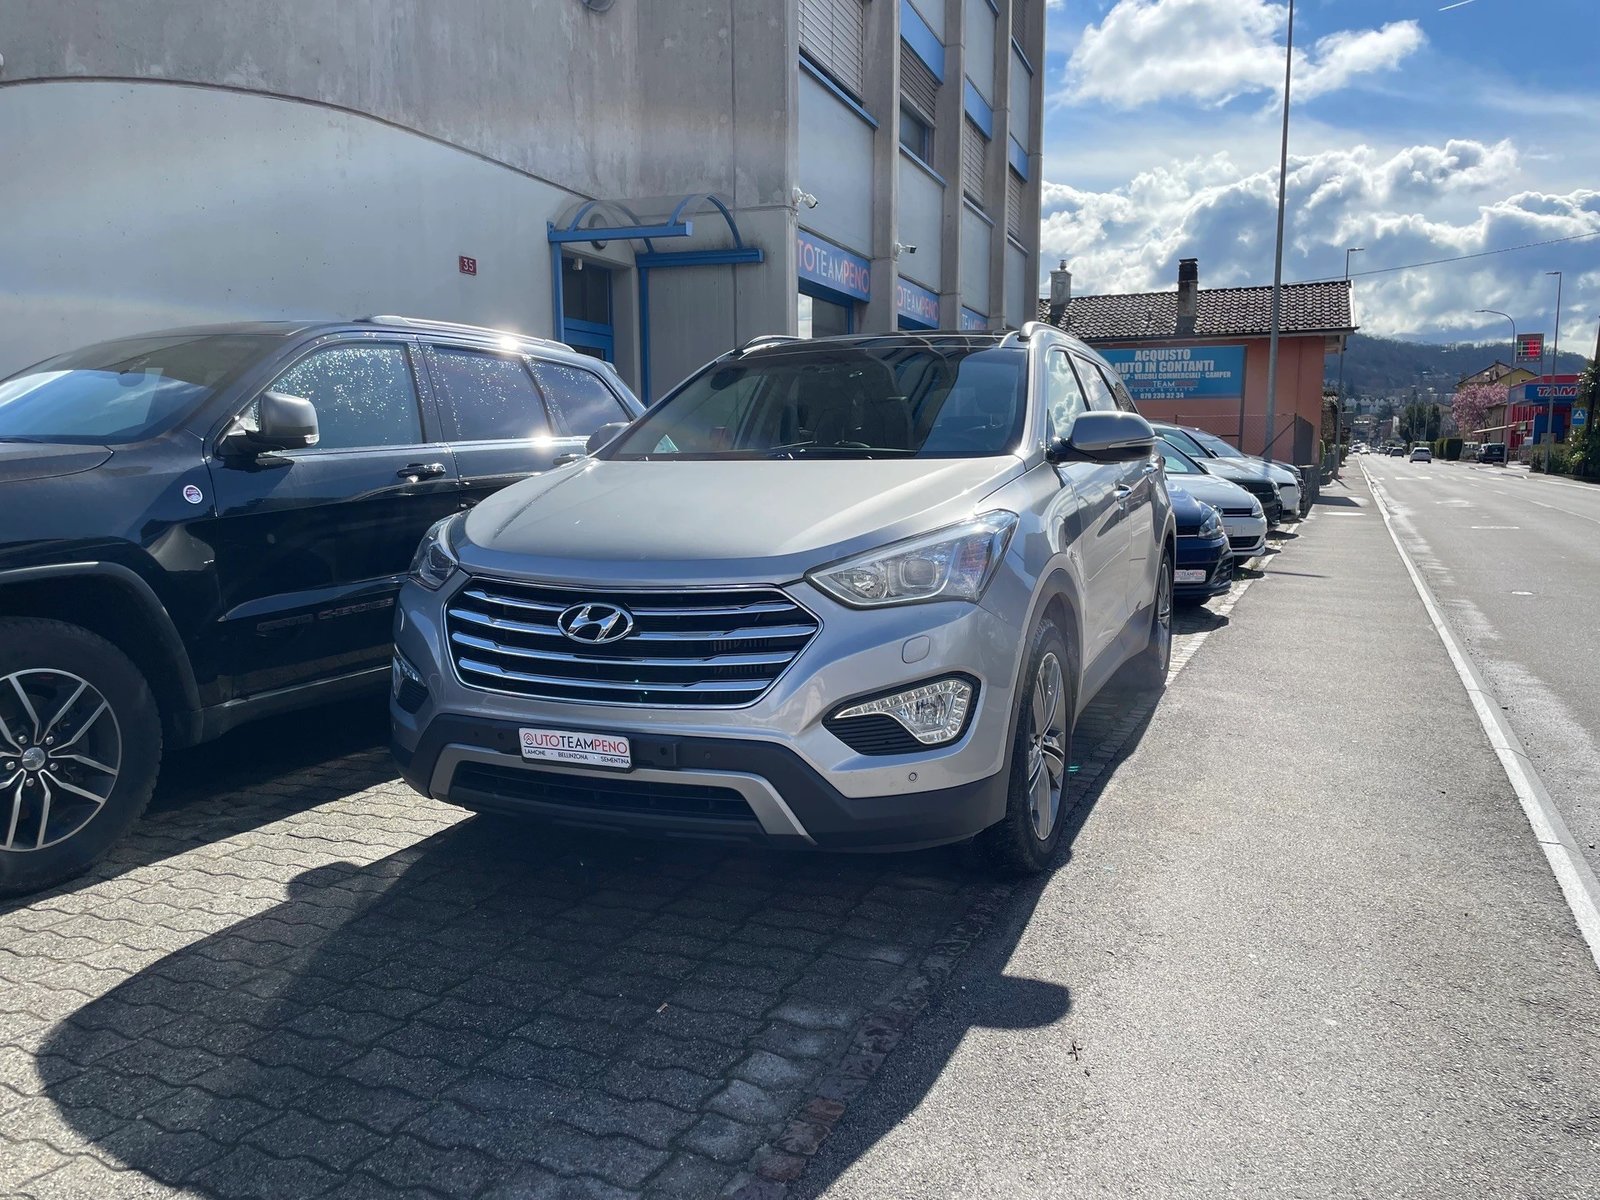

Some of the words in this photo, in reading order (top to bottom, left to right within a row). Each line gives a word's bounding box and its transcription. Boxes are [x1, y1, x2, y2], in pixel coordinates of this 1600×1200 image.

[463, 258, 474, 271] 35
[1135, 349, 1191, 361] ACQUISTO
[1115, 362, 1142, 373] AUTO
[1145, 361, 1156, 373] IN
[1159, 360, 1215, 373] CONTANTI
[1158, 372, 1201, 380] COMMERCIALI
[524, 748, 546, 756] LAMONE
[558, 751, 589, 761] BELLINZONA
[600, 755, 630, 765] SEMENTINA
